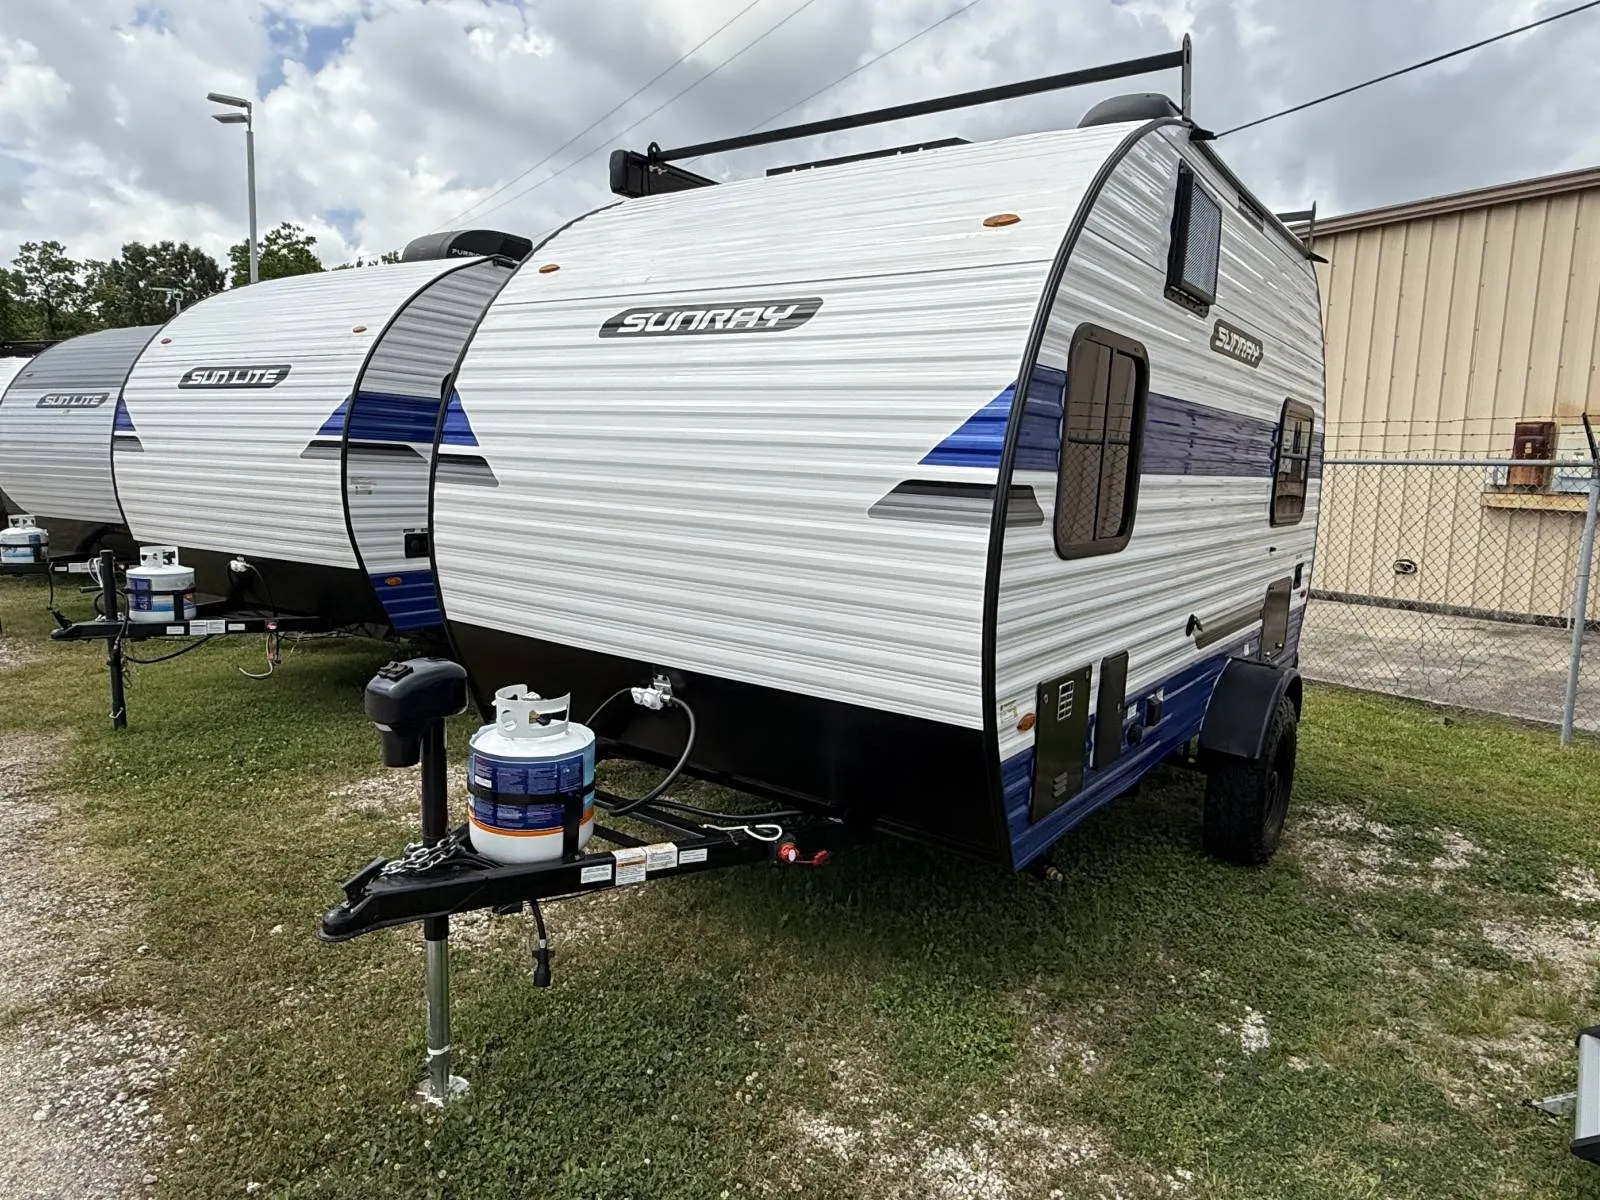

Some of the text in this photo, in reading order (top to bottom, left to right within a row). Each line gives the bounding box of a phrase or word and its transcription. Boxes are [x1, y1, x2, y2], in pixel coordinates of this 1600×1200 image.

[616, 304, 799, 333] SUNRAY
[1215, 326, 1260, 362] SUNRAY
[187, 369, 280, 385] SUN LITE
[42, 395, 103, 406] SUN LITE
